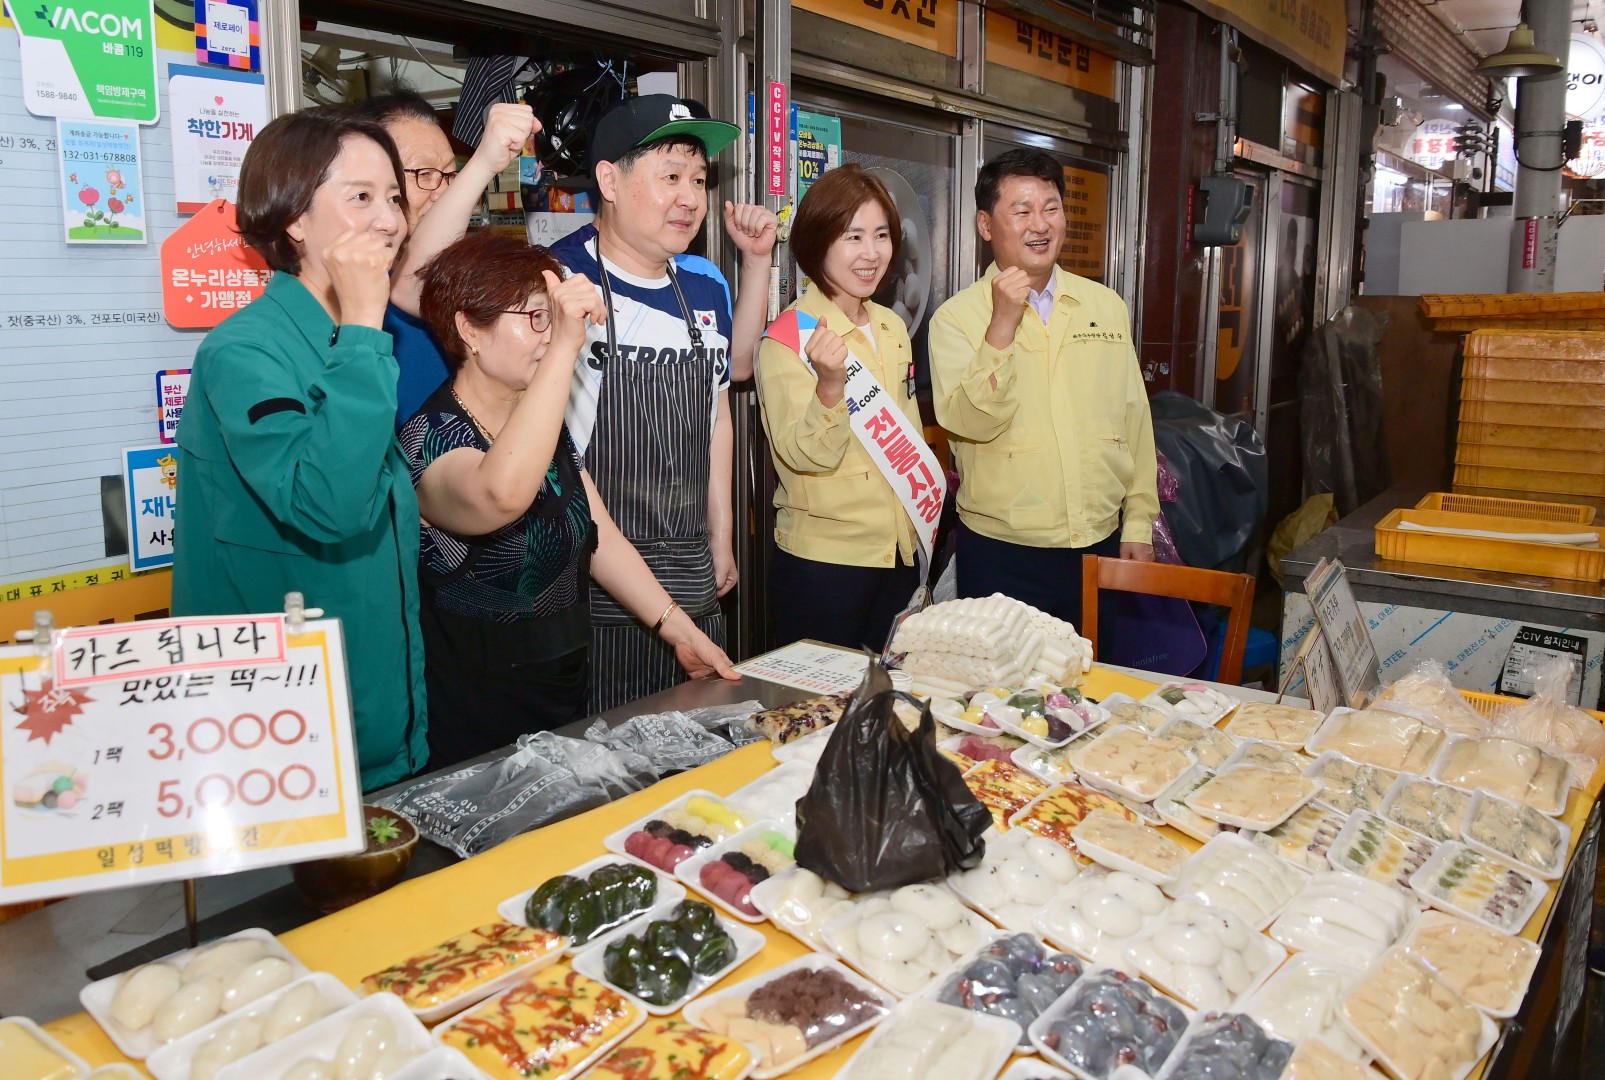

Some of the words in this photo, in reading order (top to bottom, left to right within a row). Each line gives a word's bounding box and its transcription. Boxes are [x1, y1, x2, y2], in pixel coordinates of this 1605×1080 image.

[213, 21, 243, 34] 제로페이
[36, 90, 78, 101] 1588-9840
[96, 84, 146, 99] 책임방제구역
[199, 108, 216, 116] 나눔을
[187, 117, 255, 142] 착한가게
[63, 150, 137, 163] 132-031-678808
[535, 219, 548, 234] 12
[172, 268, 275, 288] 온누리상품권
[200, 290, 252, 309] 가맹점
[91, 311, 160, 325] 건포도(미국산)
[164, 384, 181, 395] 부산
[69, 636, 140, 676] 카드
[157, 621, 266, 665] 됩니다
[1382, 648, 1407, 669] STEEL
[119, 674, 214, 706] 맛있는
[97, 827, 259, 868] 일성떡방간
